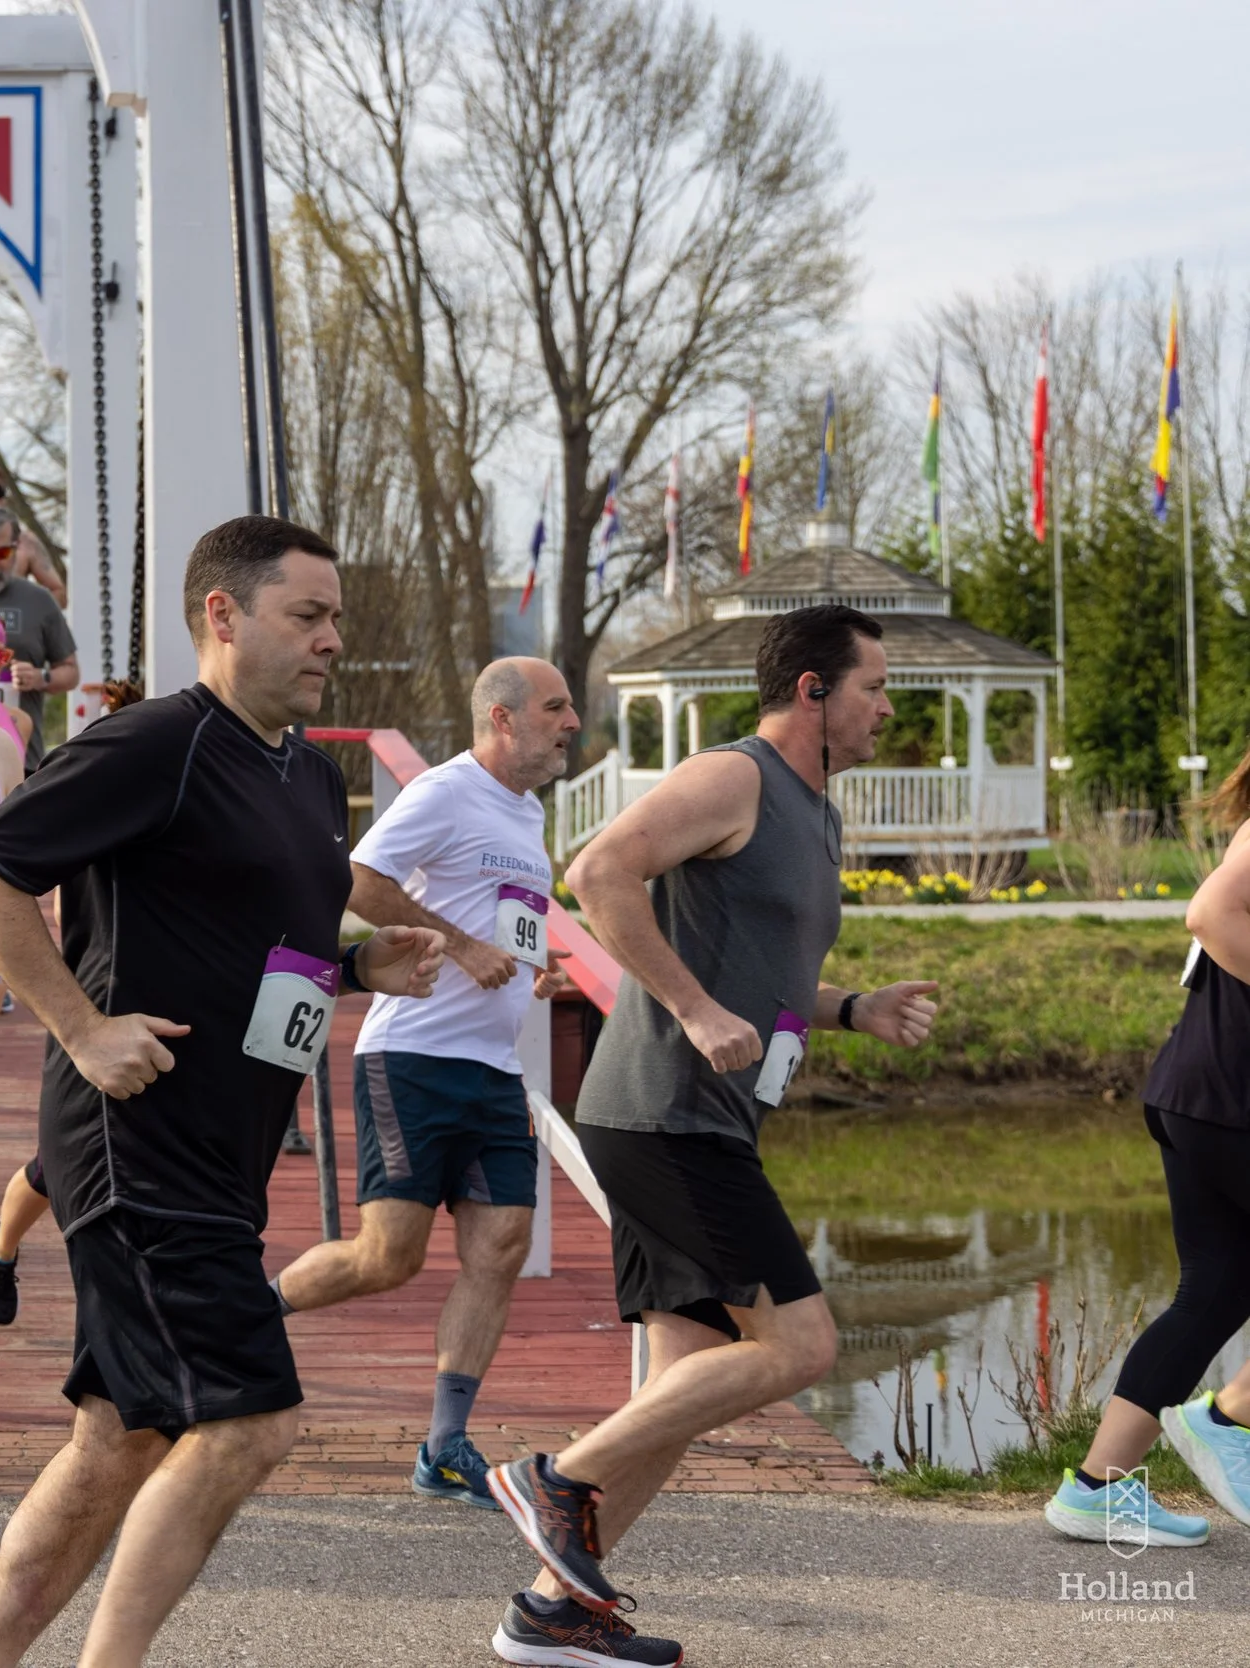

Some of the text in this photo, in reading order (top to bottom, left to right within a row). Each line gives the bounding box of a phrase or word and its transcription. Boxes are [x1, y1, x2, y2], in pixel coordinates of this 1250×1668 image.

[481, 852, 533, 874] FREEDOM
[515, 916, 537, 952] 99
[284, 1001, 325, 1053] 62
